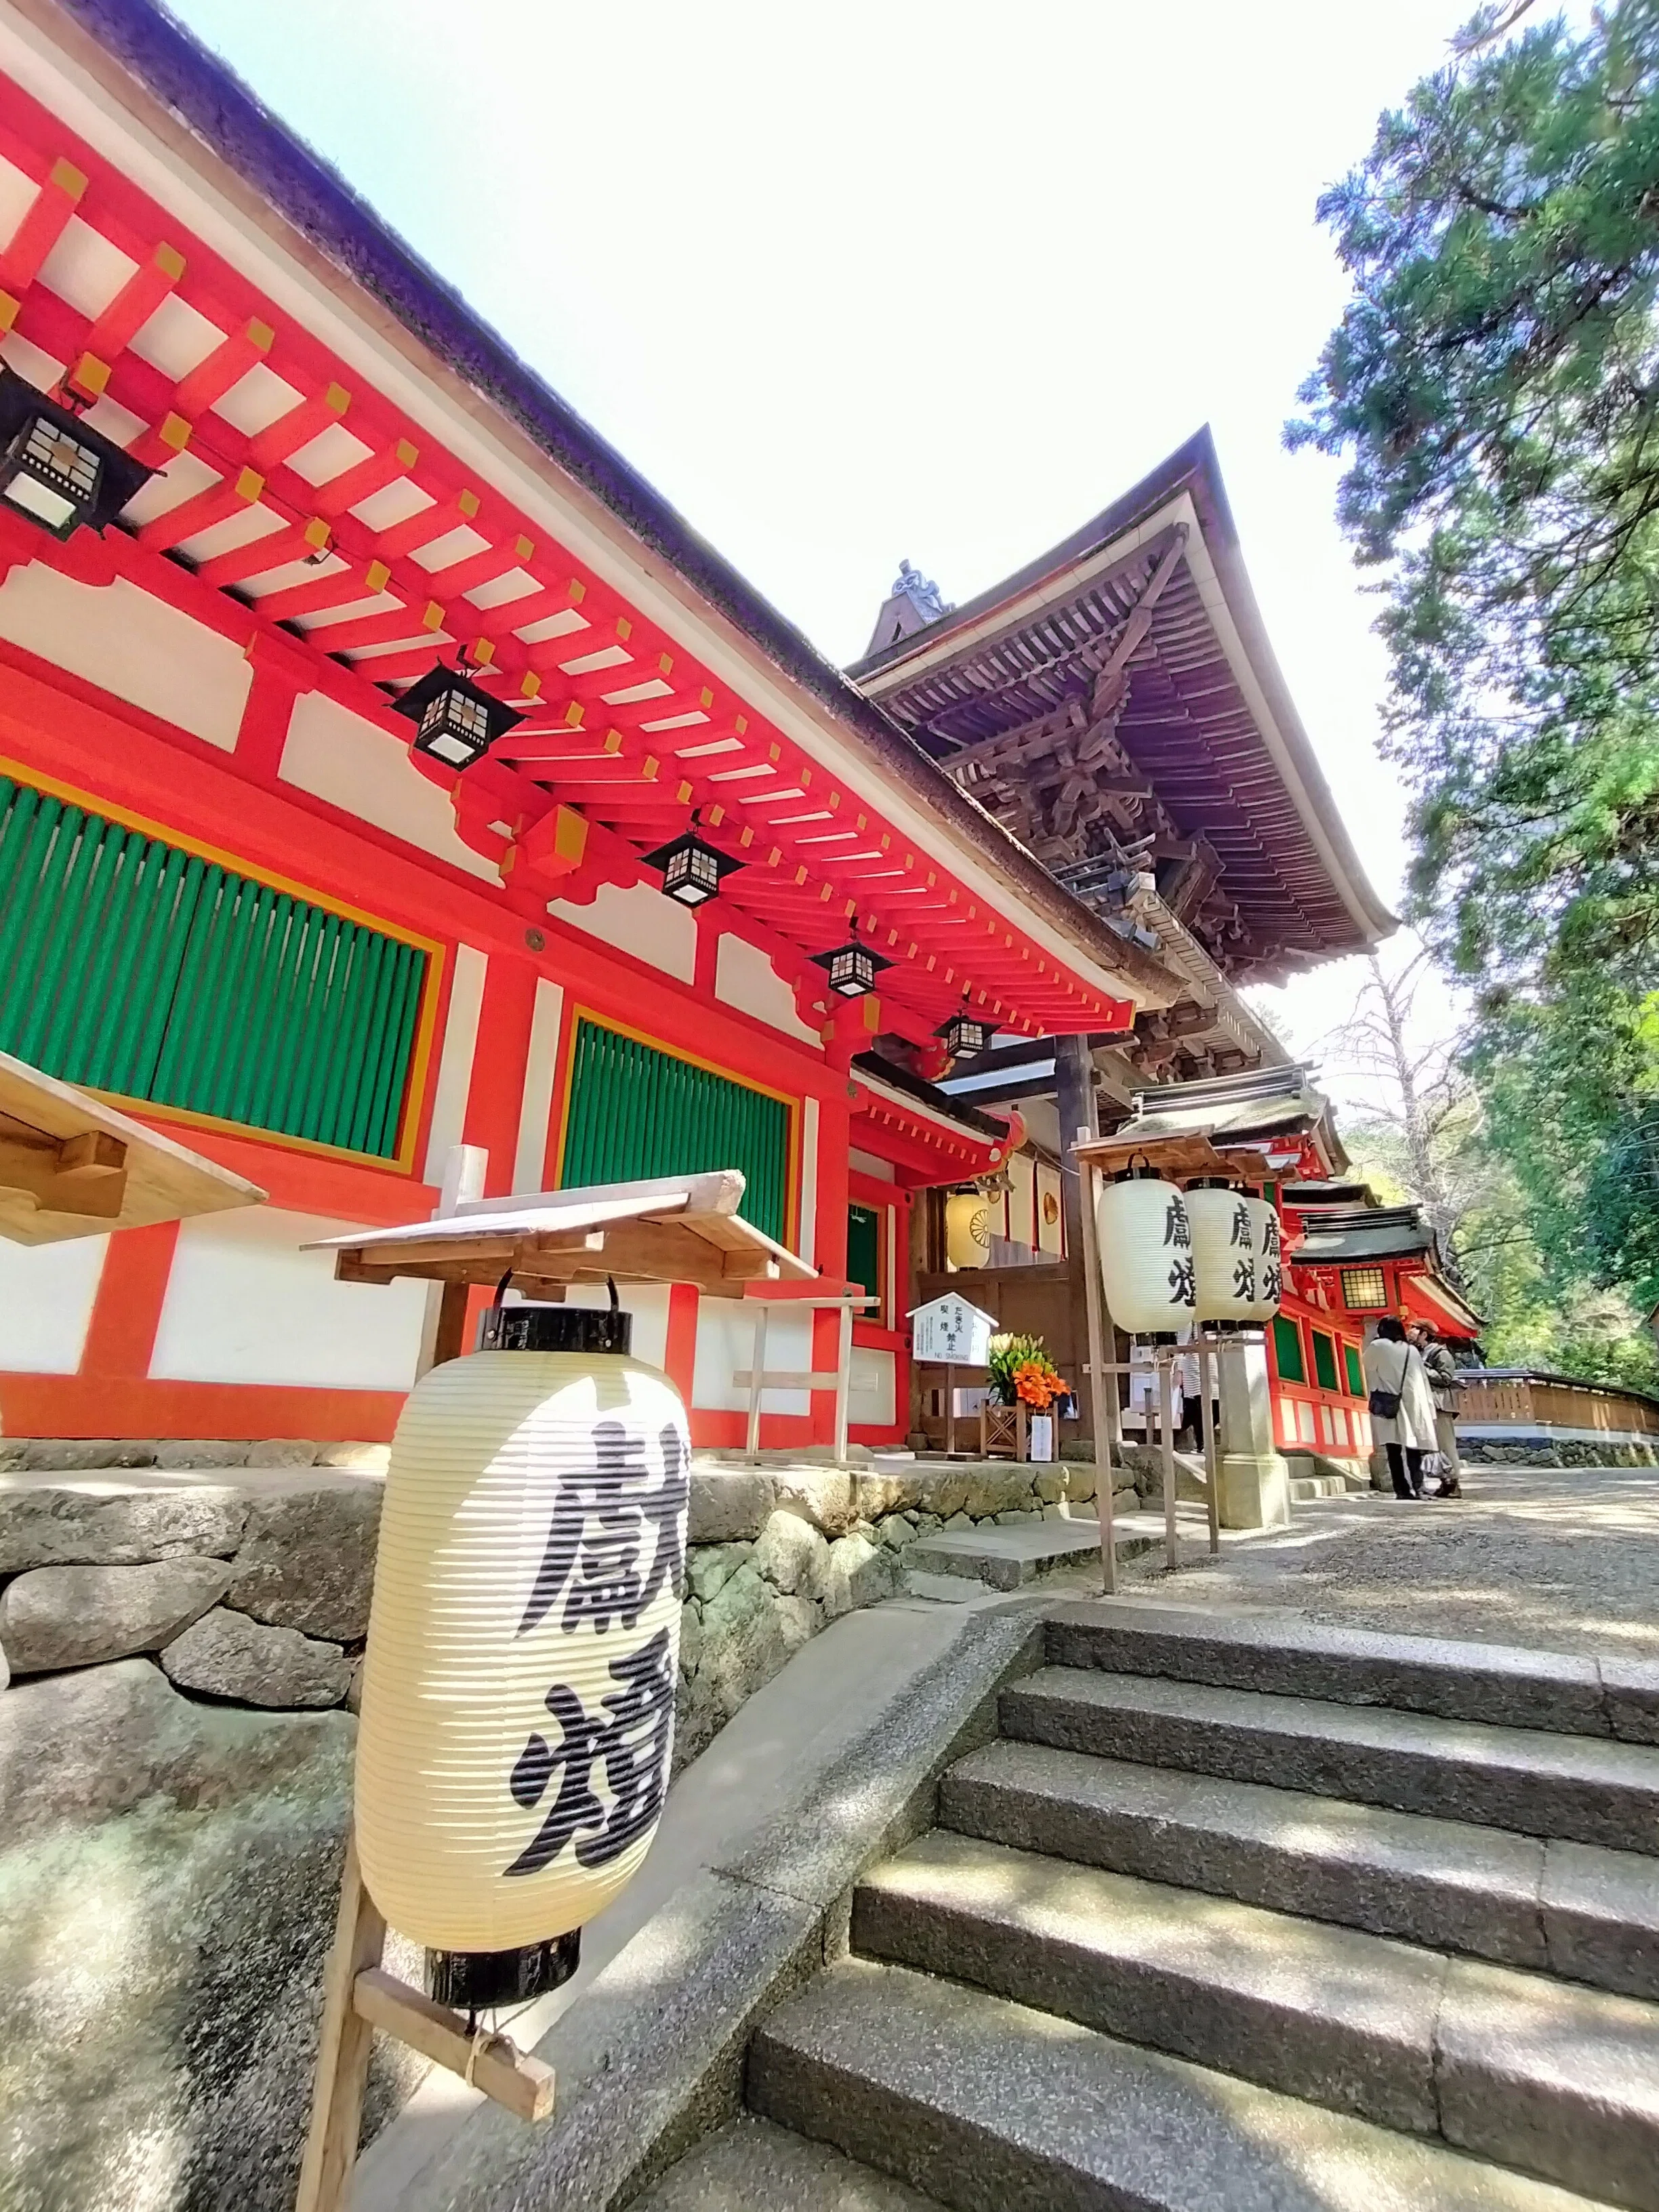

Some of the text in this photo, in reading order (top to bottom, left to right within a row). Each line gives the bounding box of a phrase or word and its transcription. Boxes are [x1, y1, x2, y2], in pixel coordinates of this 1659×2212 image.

[940, 1305, 949, 1332] 喫煙
[955, 1306, 963, 1333] たき火
[947, 1332, 956, 1351] 禁止
[945, 1352, 968, 1361] SMOKING
